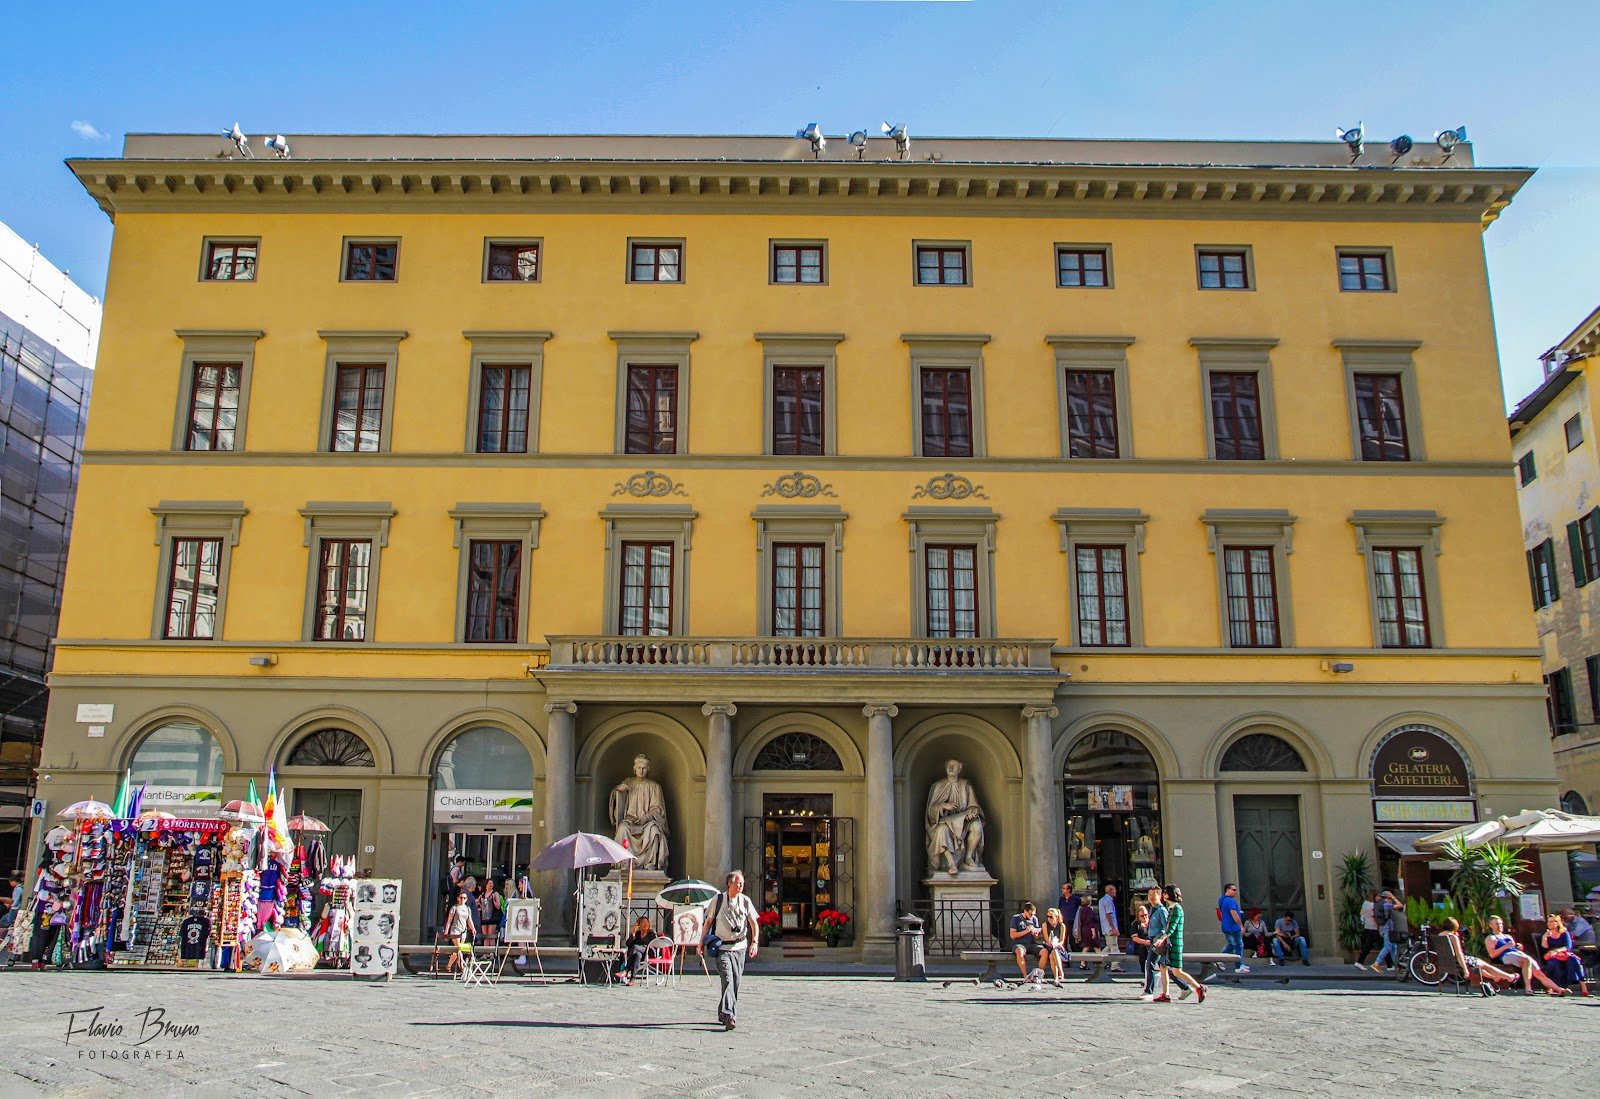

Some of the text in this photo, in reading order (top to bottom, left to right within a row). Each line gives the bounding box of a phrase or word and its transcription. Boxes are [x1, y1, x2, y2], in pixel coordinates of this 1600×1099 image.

[1388, 762, 1451, 774] GELATERIA
[1383, 773, 1459, 786] CAFFETTERIA
[440, 796, 507, 806] ChiantiBanca
[170, 820, 220, 831] FIORENTINA
